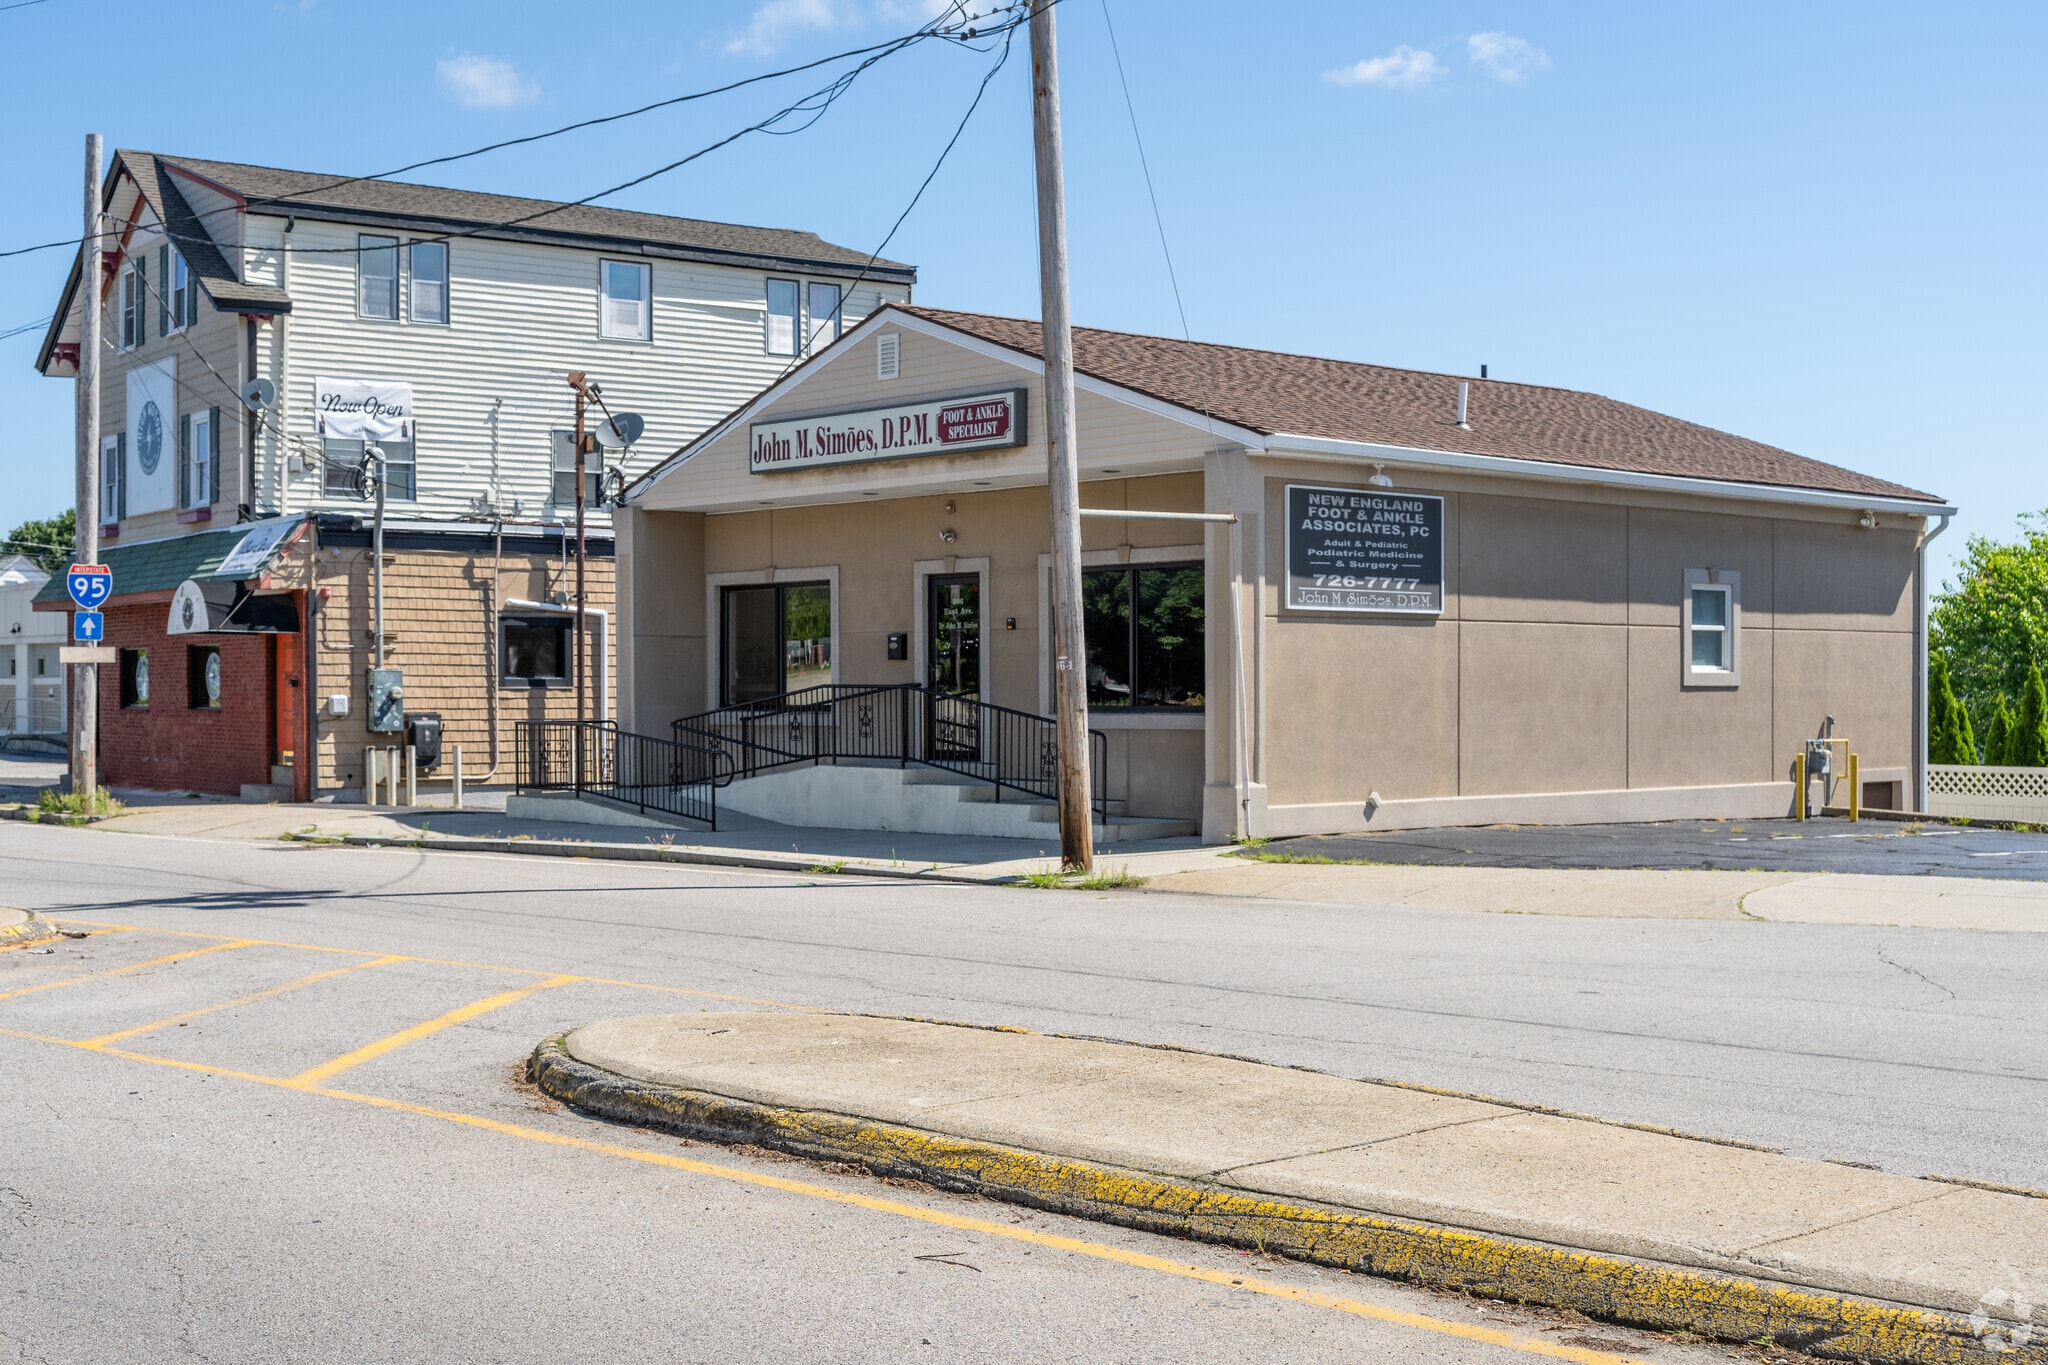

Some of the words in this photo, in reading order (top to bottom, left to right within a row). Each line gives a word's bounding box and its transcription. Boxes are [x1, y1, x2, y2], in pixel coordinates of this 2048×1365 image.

[322, 393, 361, 413] Now
[363, 396, 403, 420] Open
[943, 408, 965, 424] FOOT
[966, 408, 974, 420] &
[975, 404, 1004, 420] ANKLE
[754, 432, 791, 464] John
[795, 428, 813, 459] M.
[816, 426, 878, 456] Simões,
[881, 413, 933, 449] D.P.M.
[948, 421, 998, 439] SPECIALIST
[1308, 494, 1346, 507] NEW
[1350, 497, 1424, 512] ENGLAND
[1308, 506, 1351, 520] FOOT
[1356, 510, 1368, 521] &
[1373, 511, 1425, 524] ANKLE
[1301, 519, 1405, 537] ASSOCIATES,
[1409, 526, 1430, 537] PC
[1324, 539, 1351, 547] Adult
[1365, 540, 1408, 549] Pediatric
[1307, 549, 1365, 557] Podiatric
[1368, 550, 1424, 559] Medicine
[1335, 560, 1345, 568] &
[1349, 561, 1399, 570] Surgery
[74, 577, 105, 598] 95
[1312, 574, 1420, 590] 726-7777
[1298, 591, 1329, 603] John
[1332, 592, 1344, 604] M.
[1397, 595, 1433, 607] D.P.M.
